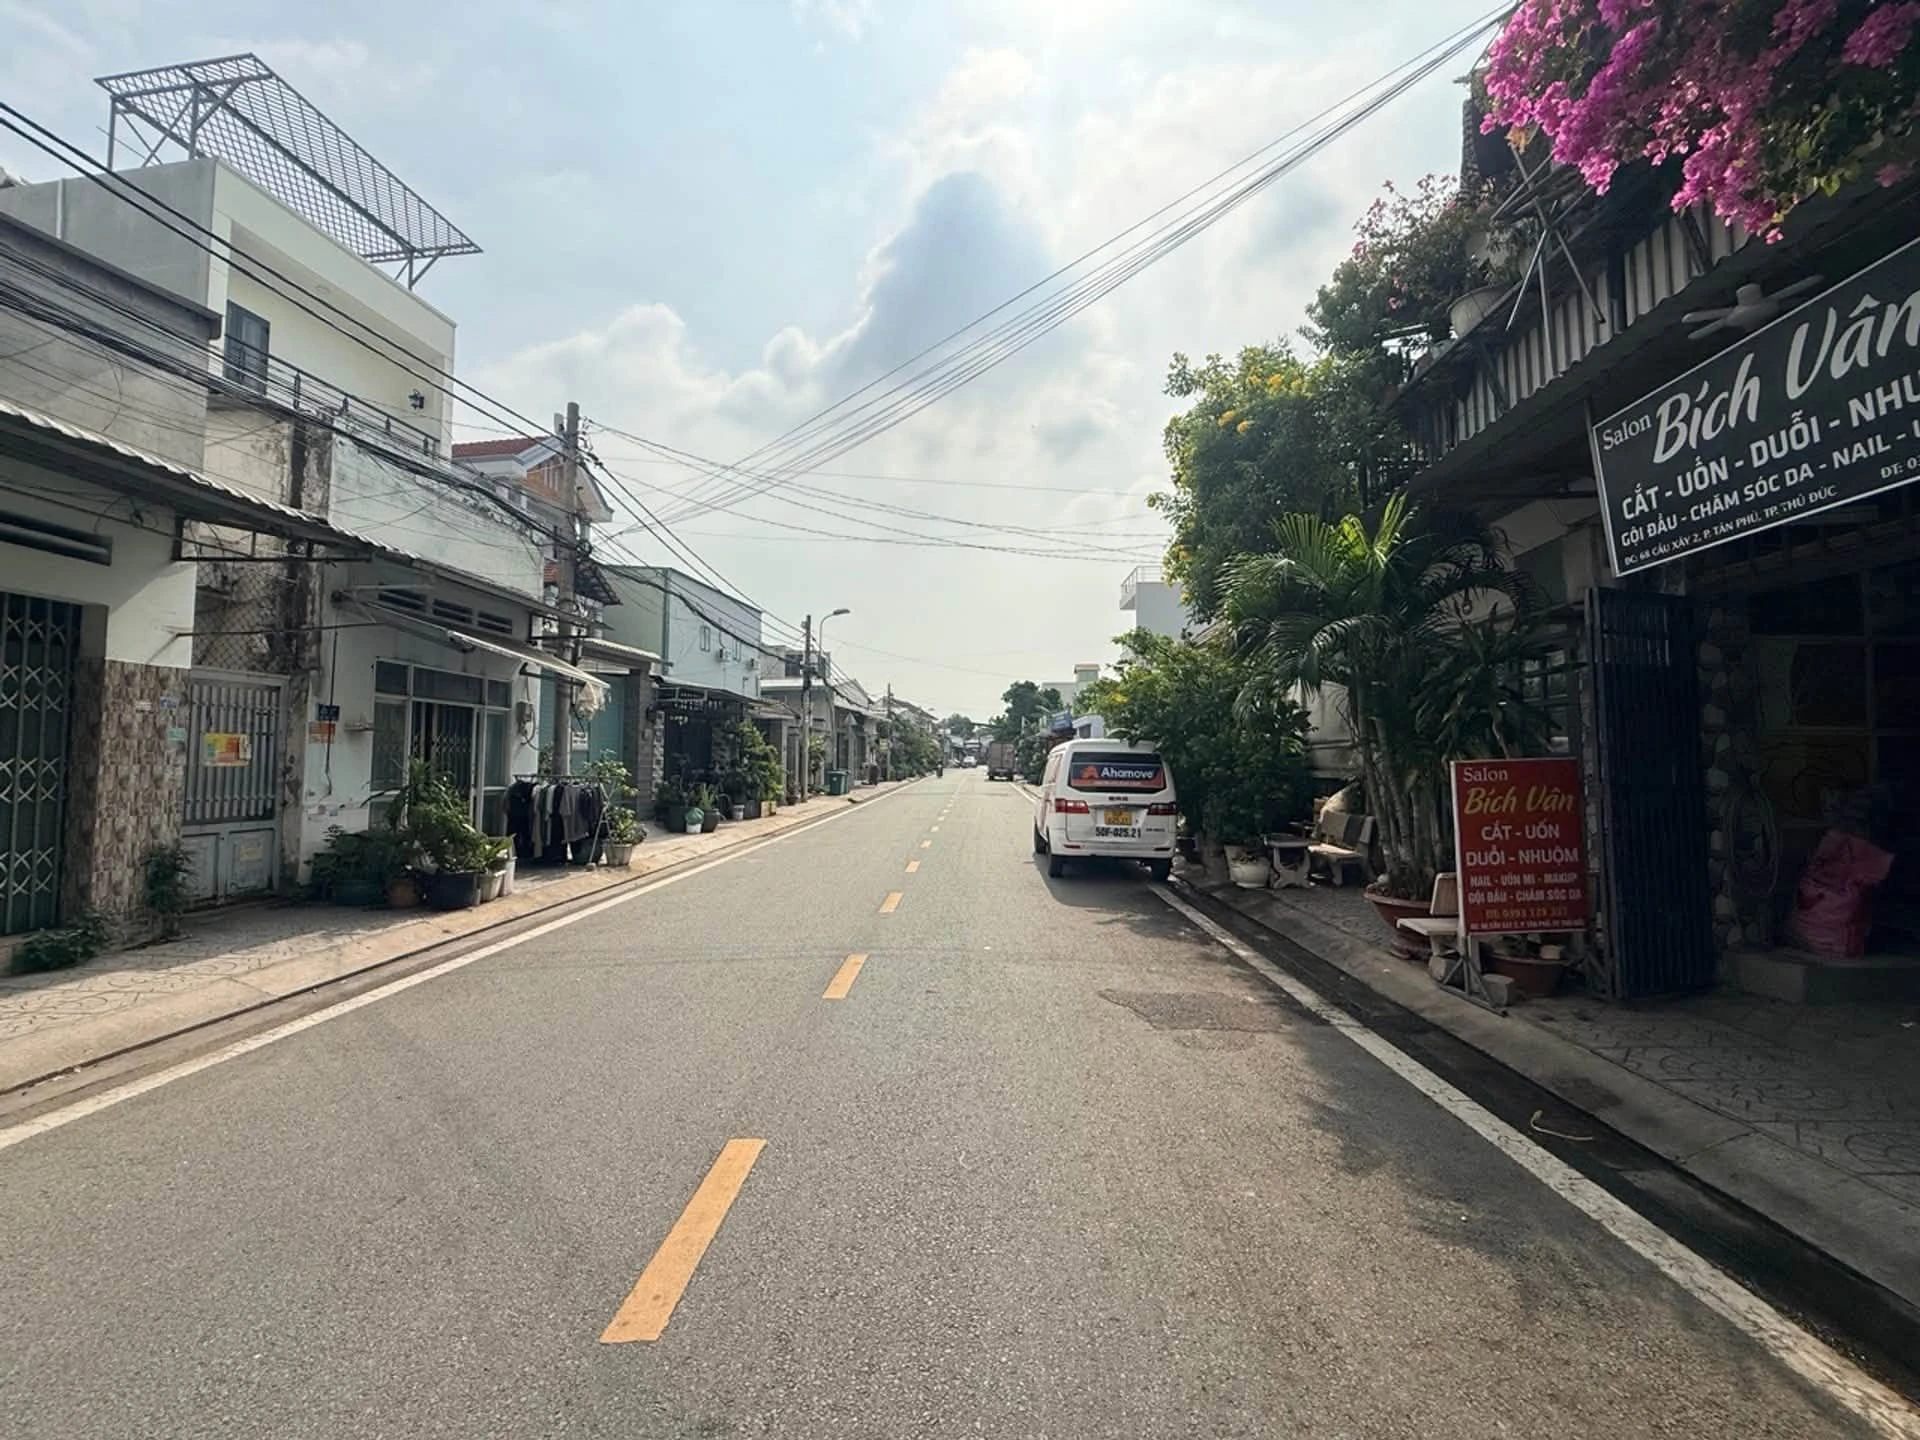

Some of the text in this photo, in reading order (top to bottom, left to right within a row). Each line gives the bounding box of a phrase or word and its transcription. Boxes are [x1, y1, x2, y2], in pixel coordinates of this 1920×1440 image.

[1653, 289, 1920, 464] Bích Vân
[1602, 413, 1652, 450] Salon
[1622, 482, 1659, 520] CẮT
[1749, 409, 1821, 469] DUỖI
[1621, 525, 1645, 547] GỘI
[1690, 490, 1740, 521] CHĂM
[1743, 475, 1780, 502] SÓC
[1784, 463, 1815, 487] DA
[1832, 434, 1892, 469] NAIL
[1764, 505, 1780, 518] TP.
[1101, 766, 1154, 779] Ahamove
[1463, 766, 1508, 783] Salon
[1464, 784, 1575, 815] Bích Vân
[1519, 847, 1579, 867] NHUỘM
[1470, 875, 1492, 887] NAIL
